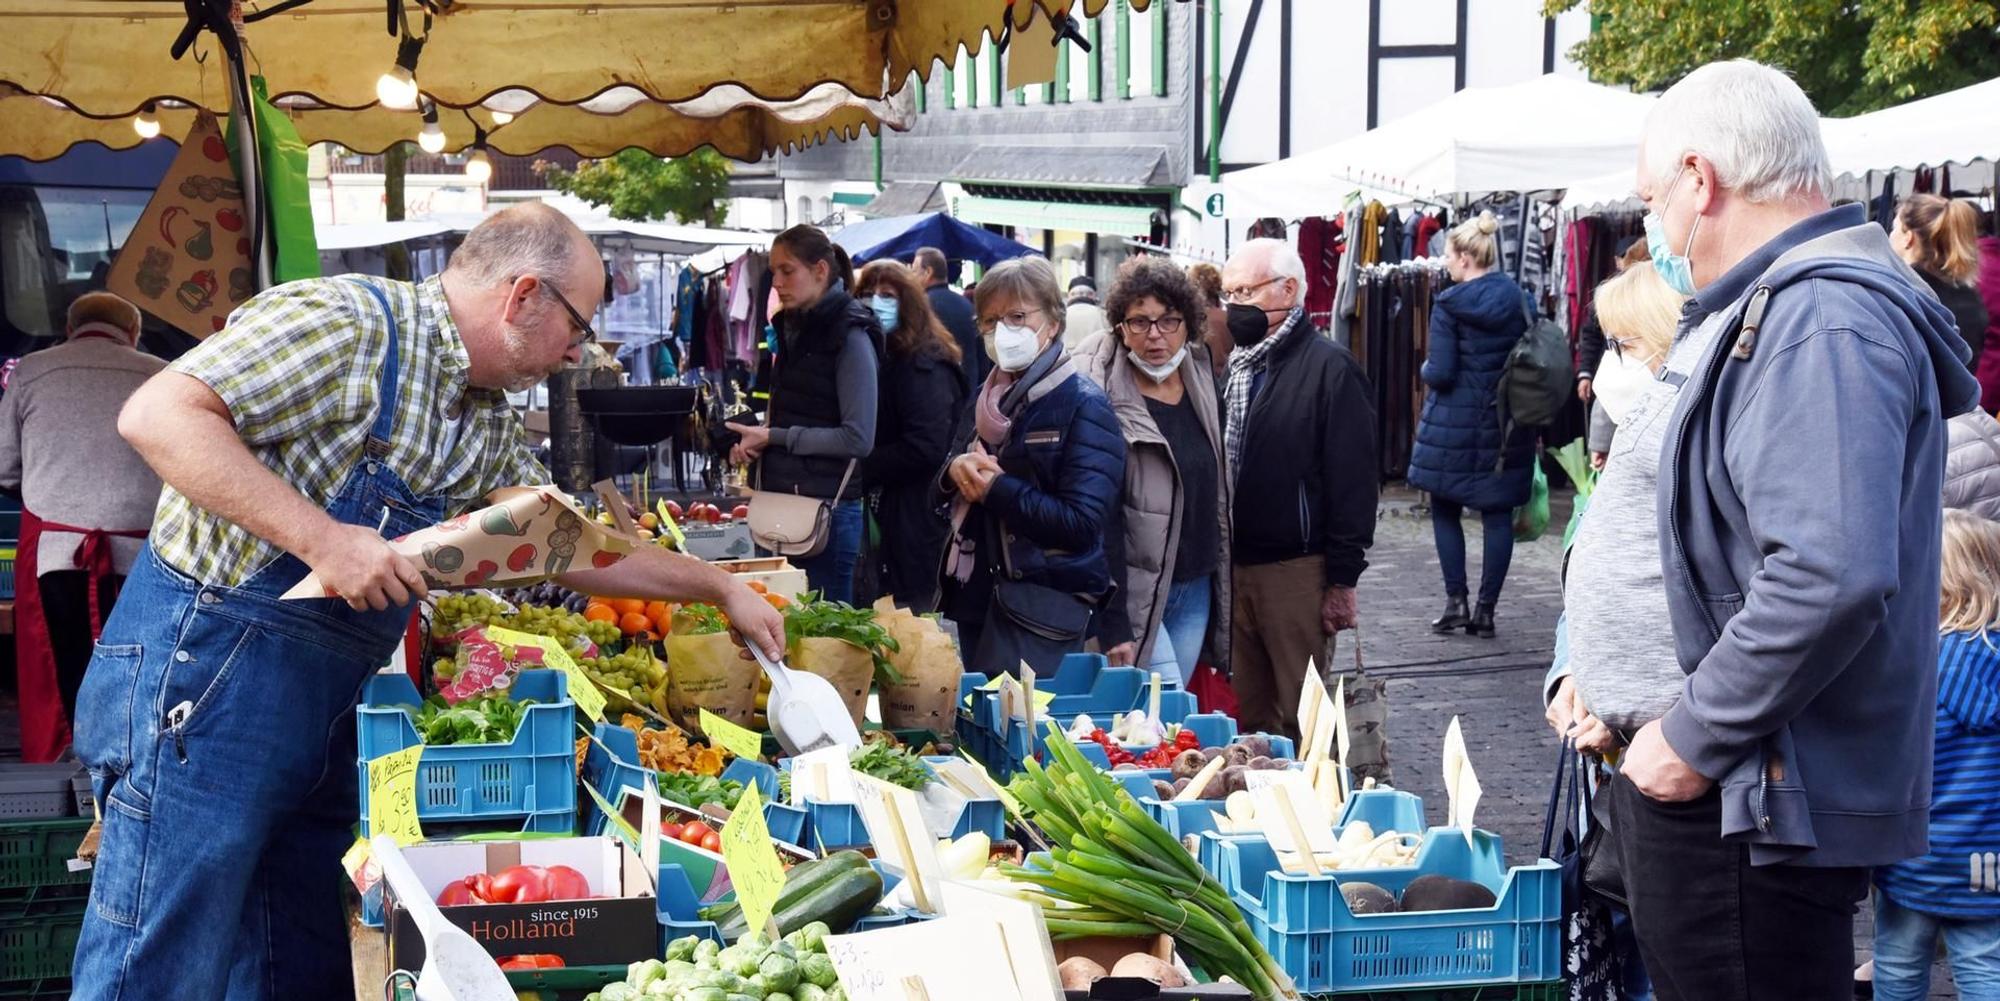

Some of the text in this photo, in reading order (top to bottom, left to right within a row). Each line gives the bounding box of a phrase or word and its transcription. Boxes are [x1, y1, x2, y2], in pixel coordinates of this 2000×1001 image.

[531, 907, 599, 921] since 1915
[472, 917, 576, 940] Holland
